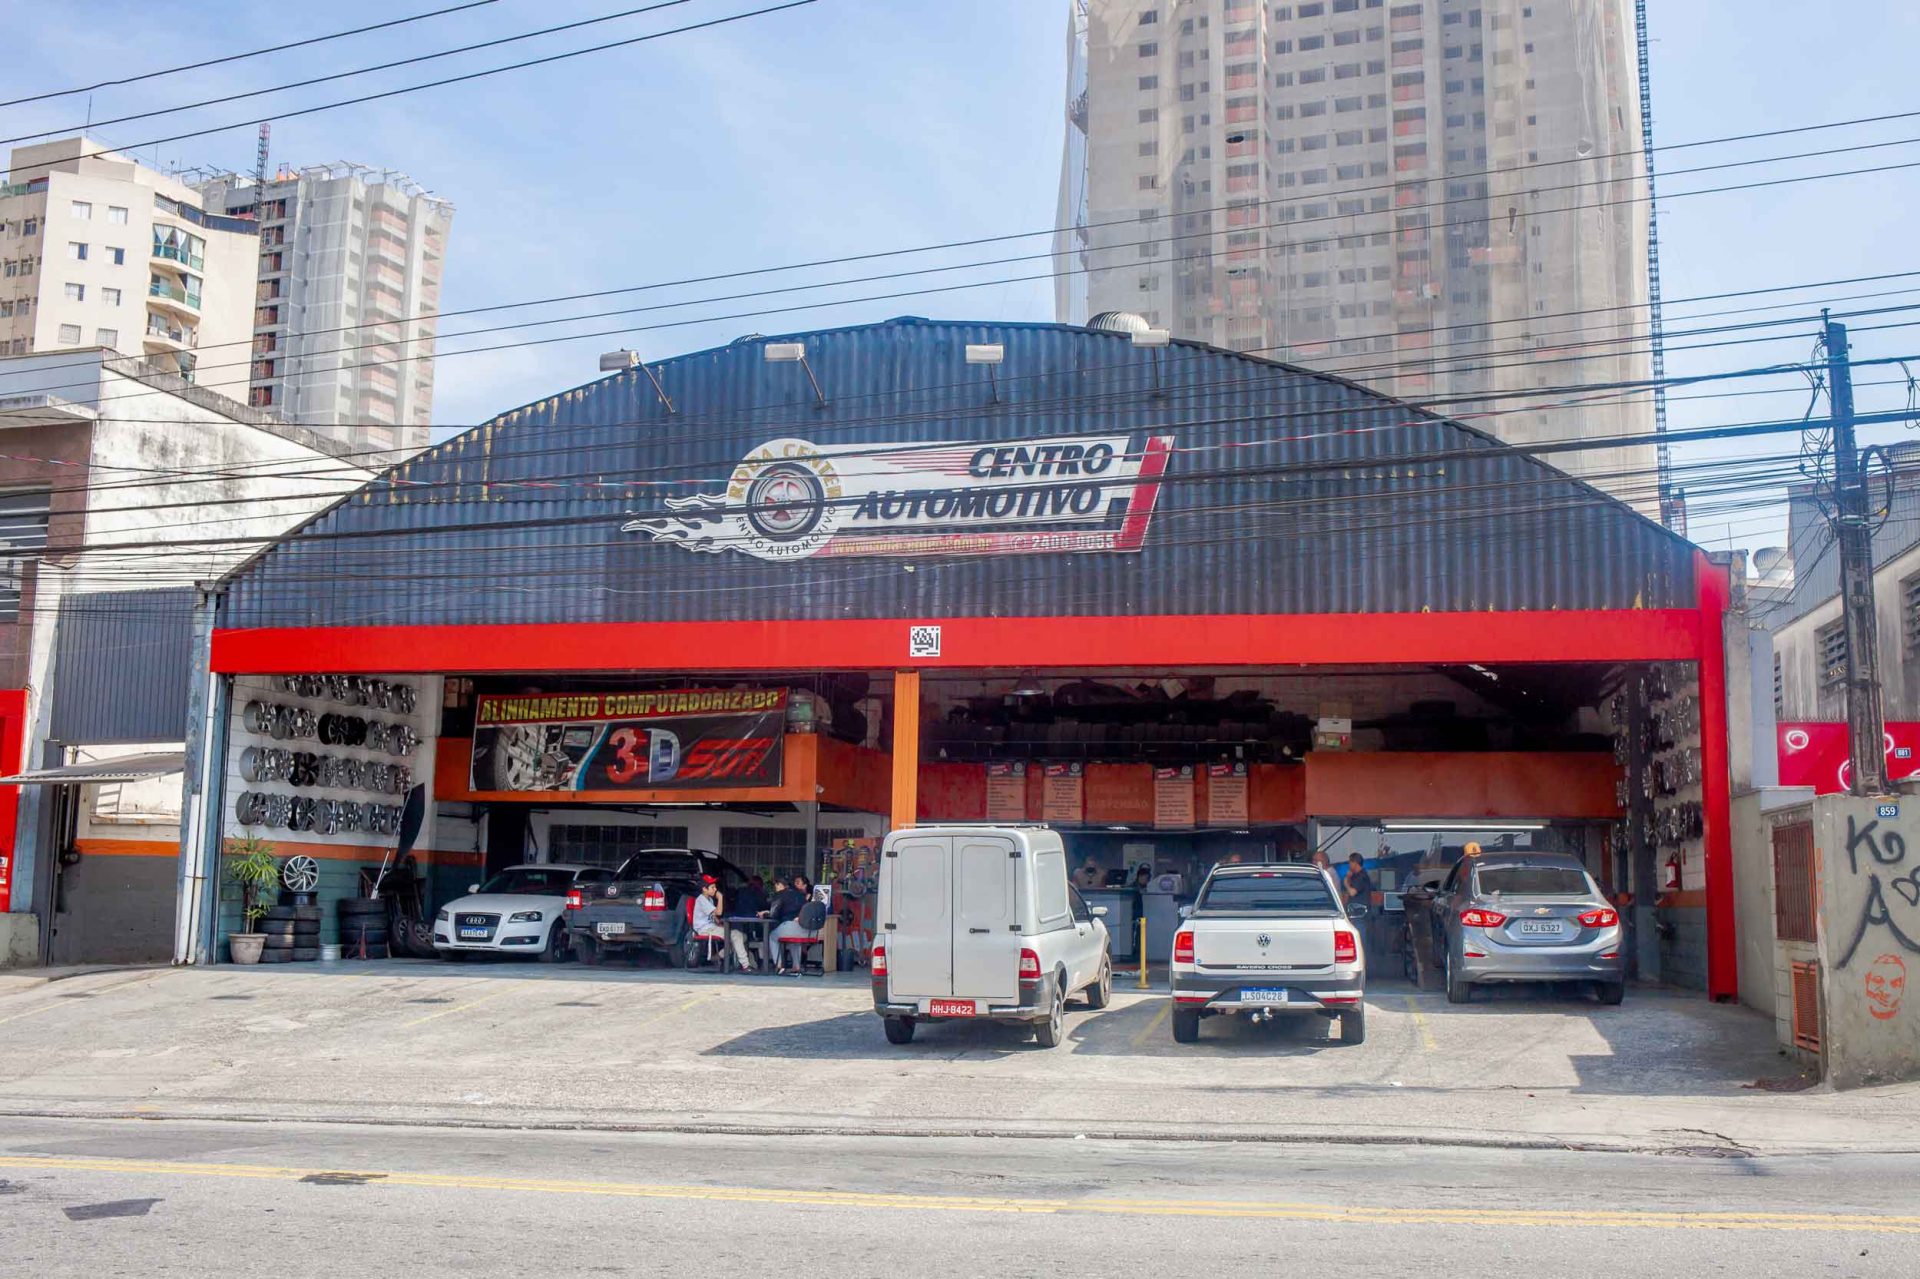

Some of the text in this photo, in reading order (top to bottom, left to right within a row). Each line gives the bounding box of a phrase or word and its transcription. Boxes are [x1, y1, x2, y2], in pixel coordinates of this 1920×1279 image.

[968, 443, 1114, 478] CENTRO
[851, 486, 1102, 521] AUTOMOTIVO
[736, 506, 836, 555] ENTRO AUTOMOTIVO
[481, 692, 779, 722] ALINHAMENTO COMPUTADORIZADO
[606, 727, 681, 784] 3D
[1880, 806, 1896, 816] 859
